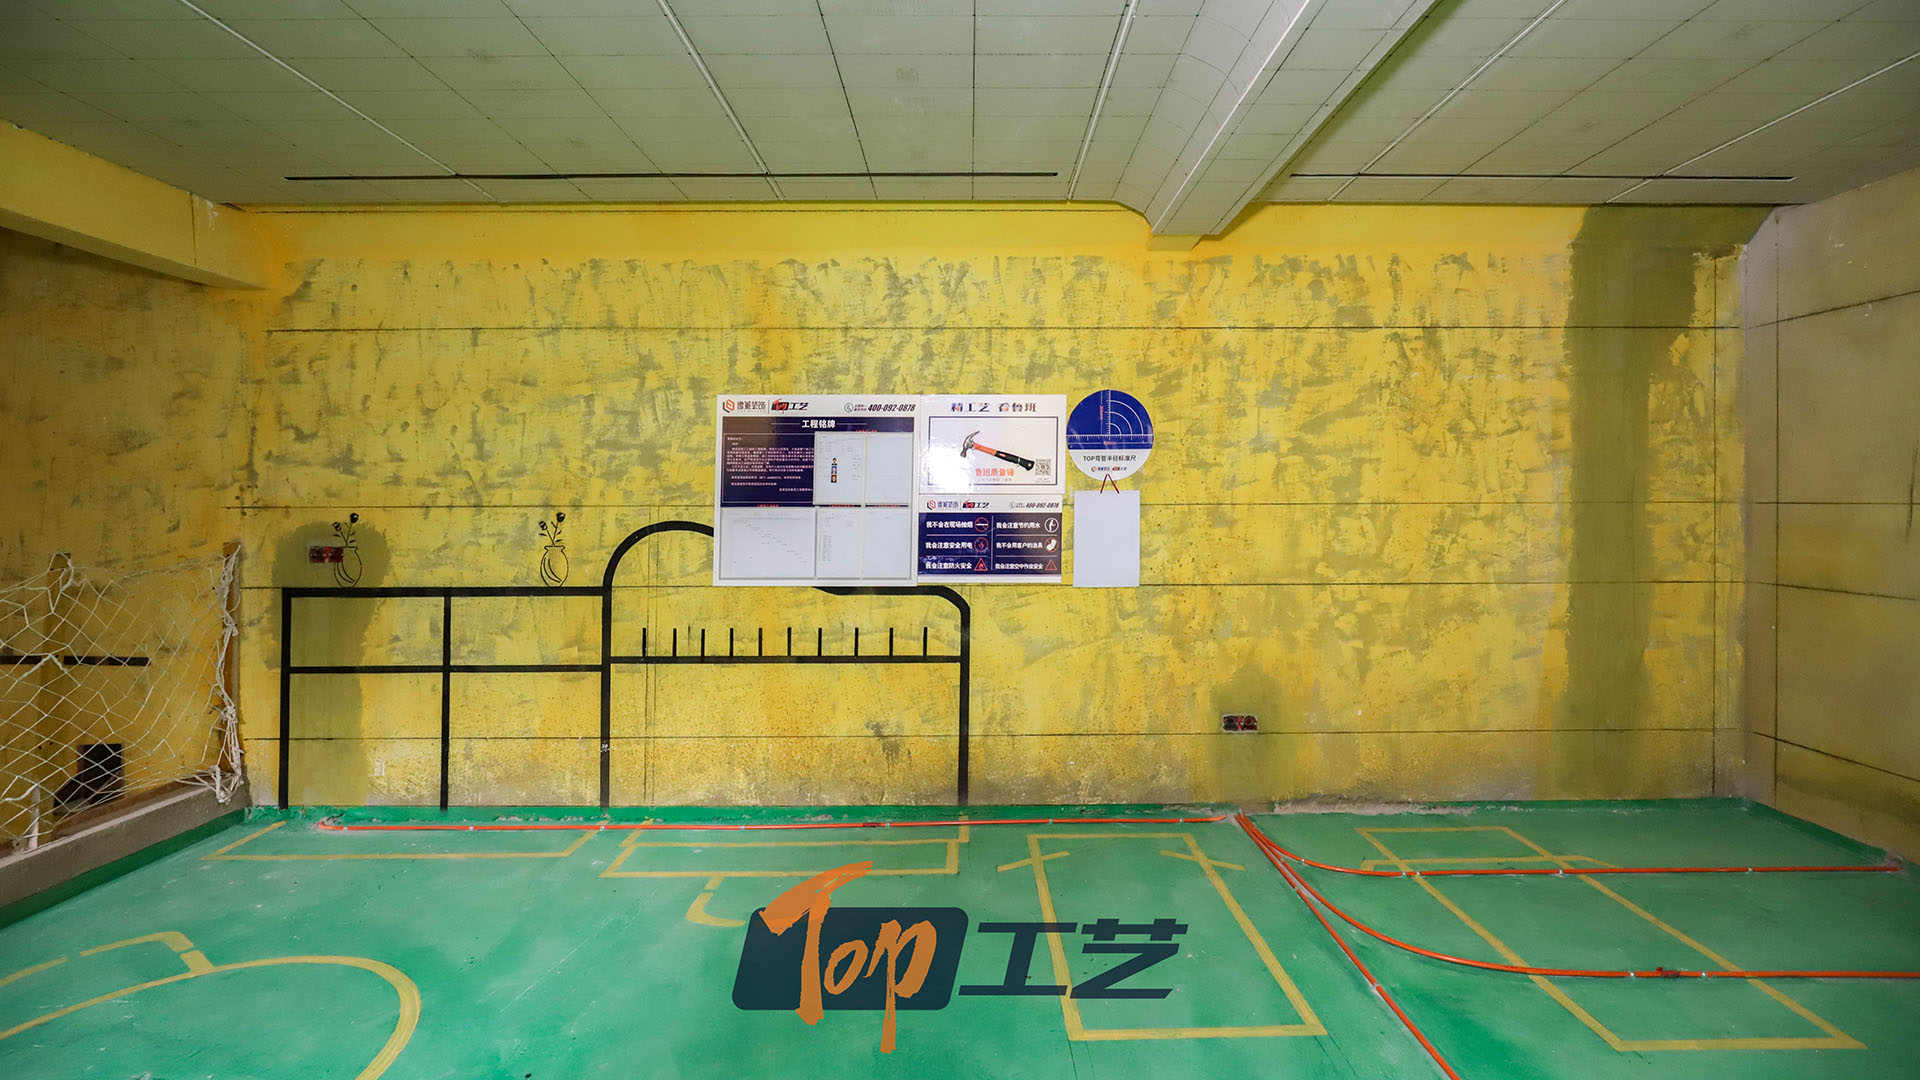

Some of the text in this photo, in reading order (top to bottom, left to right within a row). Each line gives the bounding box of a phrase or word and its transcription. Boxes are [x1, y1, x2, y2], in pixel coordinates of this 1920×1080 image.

[868, 403, 916, 412] 400-092-0878
[951, 402, 1037, 412] 精工艺 看鲁班
[801, 419, 836, 429] 工程铭牌
[925, 541, 973, 549] 我会注意安全用电
